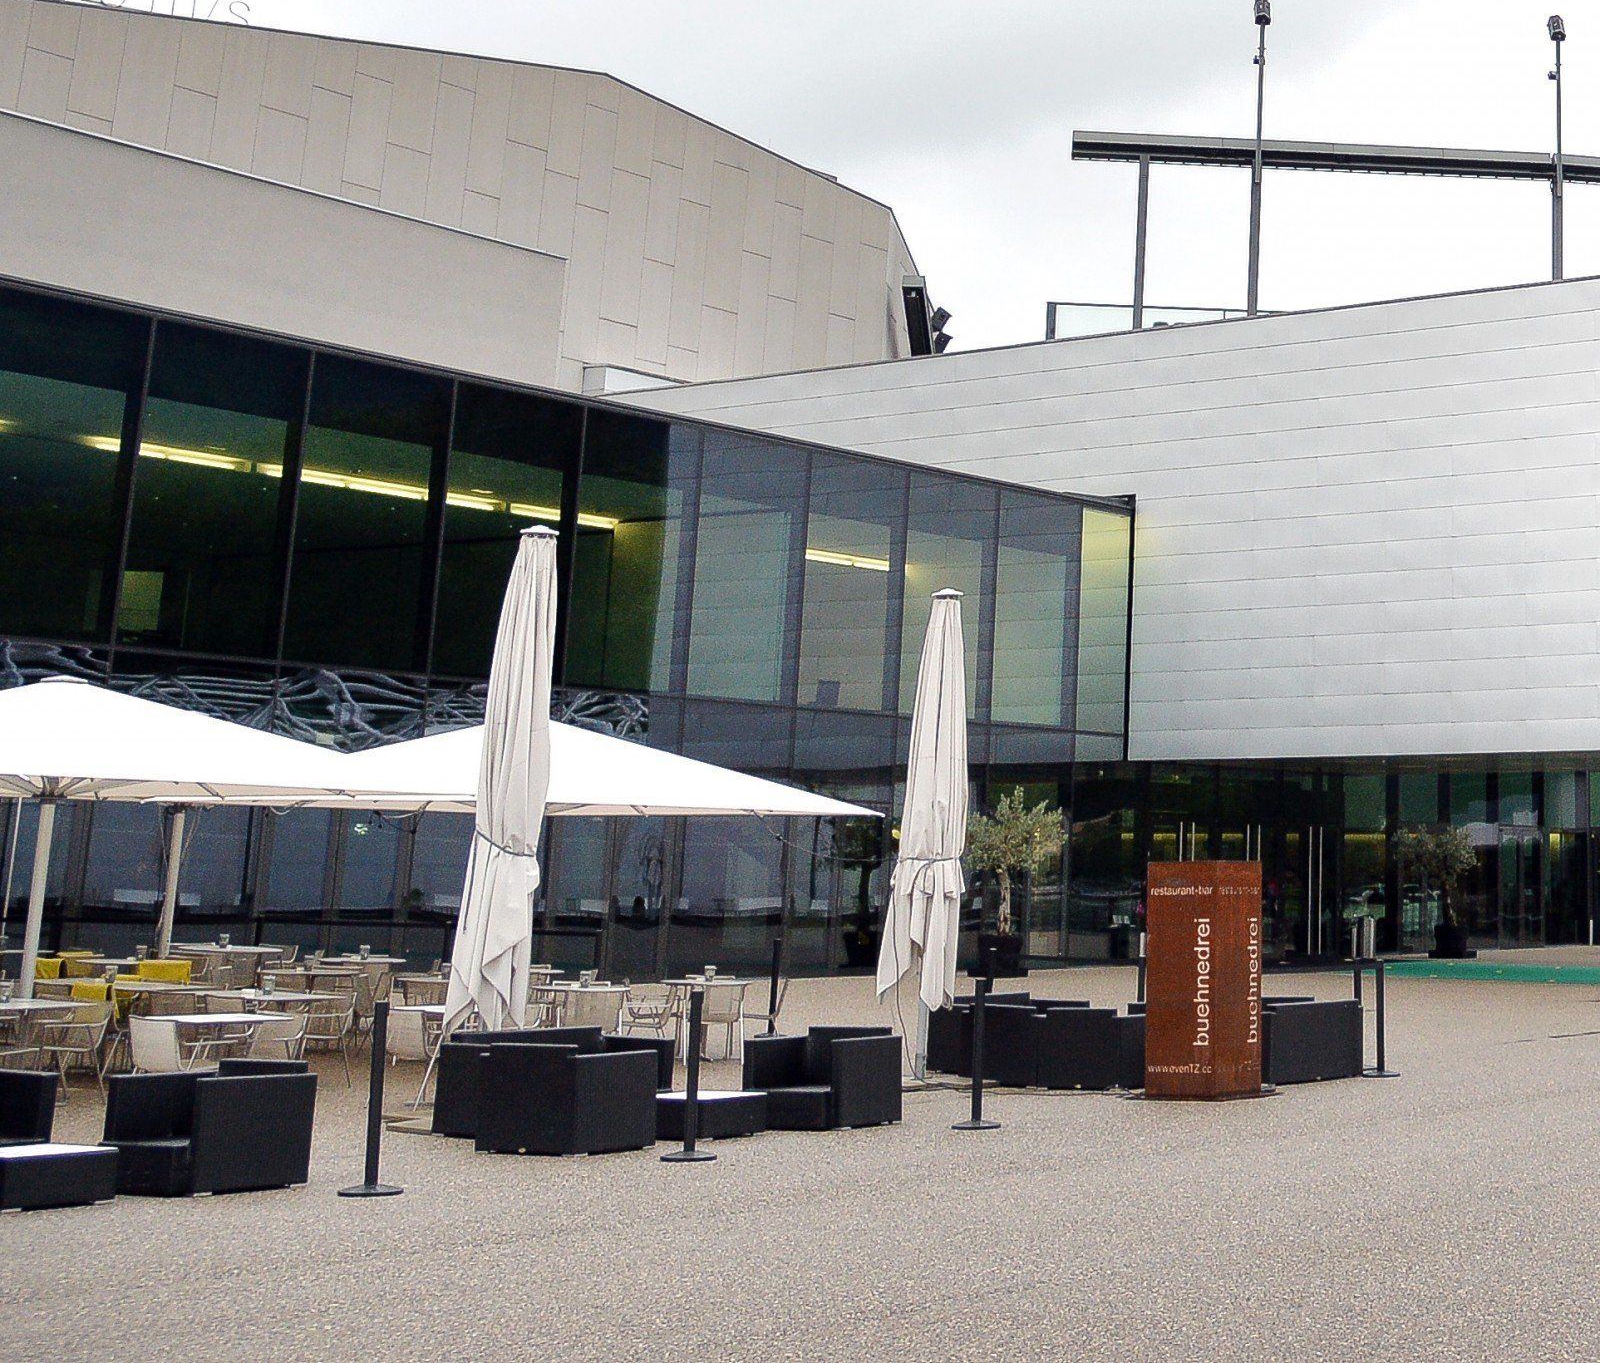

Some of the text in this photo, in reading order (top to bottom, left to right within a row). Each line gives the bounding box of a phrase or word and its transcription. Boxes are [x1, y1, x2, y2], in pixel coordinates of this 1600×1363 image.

[1192, 917, 1211, 1047] buehnedrei
[1246, 916, 1258, 1044] buehnedrei
[1147, 1063, 1213, 1074] wwwevenTZcc
